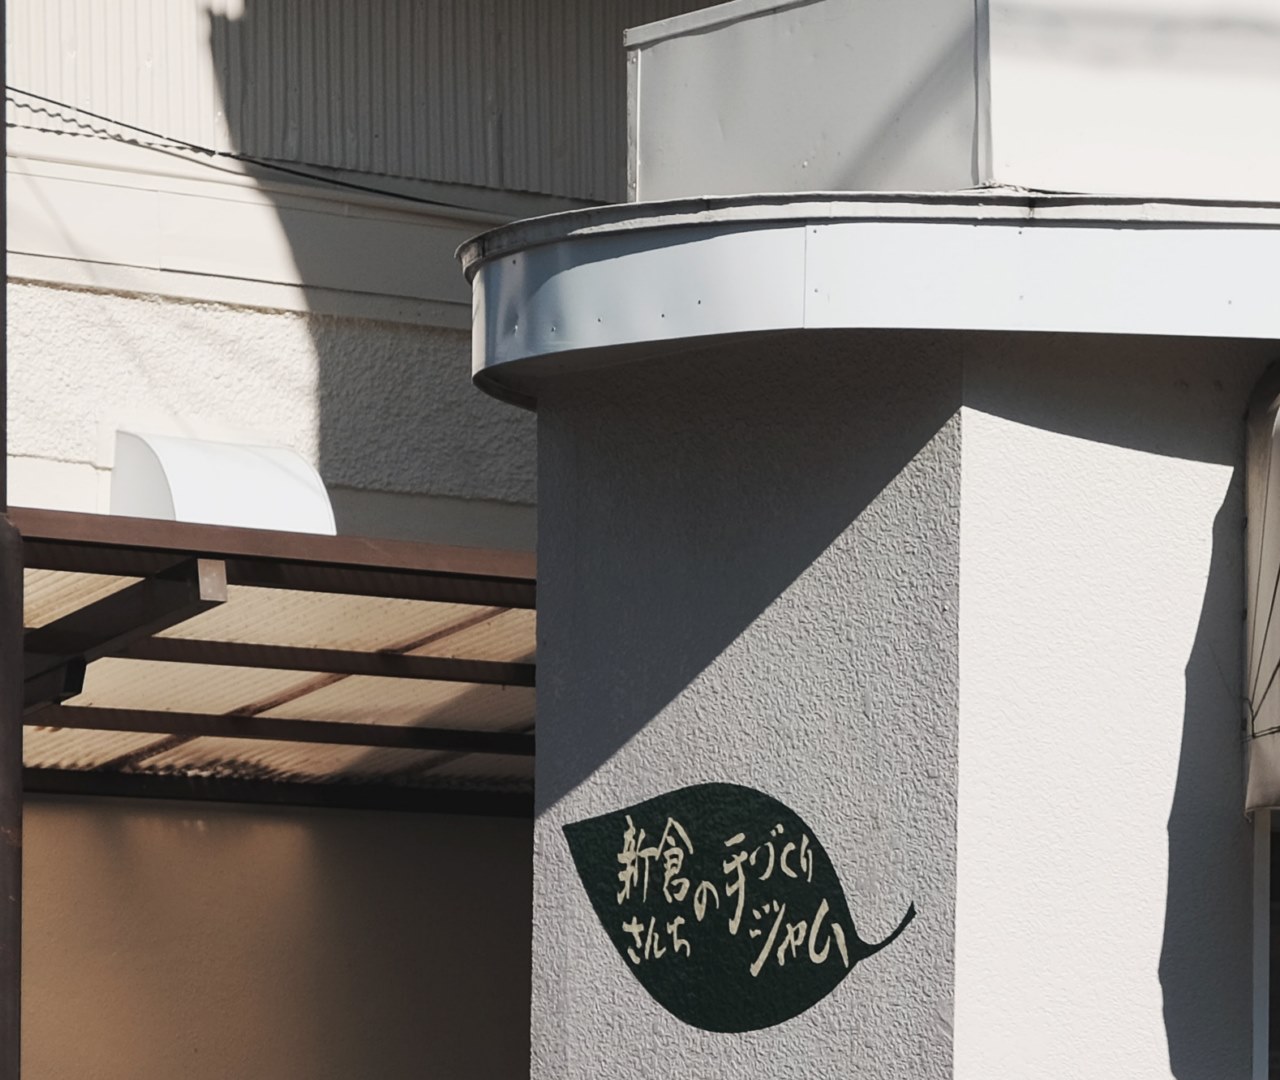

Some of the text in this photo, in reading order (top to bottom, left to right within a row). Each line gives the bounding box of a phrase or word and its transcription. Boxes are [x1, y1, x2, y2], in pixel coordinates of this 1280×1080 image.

[617, 815, 694, 905] 新倉
[723, 823, 814, 935] 手づくり
[622, 915, 692, 966] さんち
[749, 899, 850, 977] ジャム
